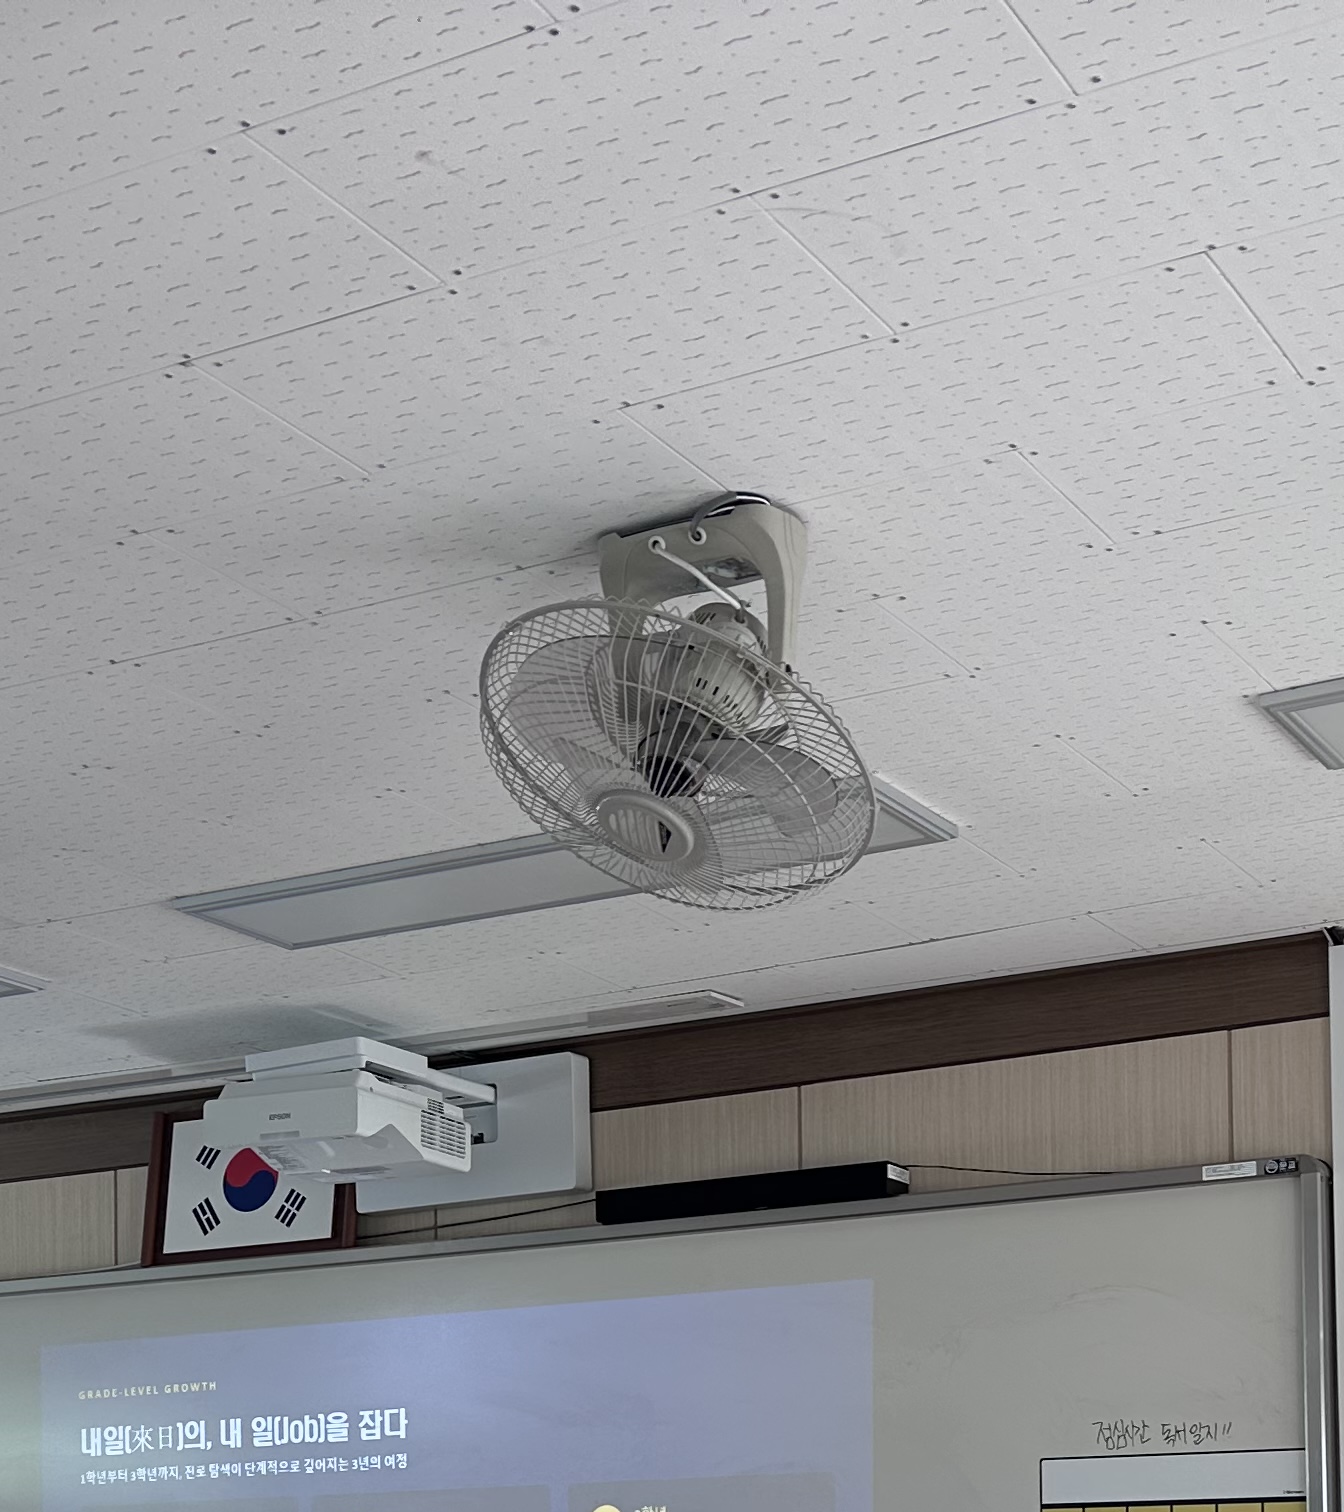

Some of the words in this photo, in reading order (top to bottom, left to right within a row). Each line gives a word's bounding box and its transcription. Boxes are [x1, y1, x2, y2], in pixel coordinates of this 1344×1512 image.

[78, 1384, 159, 1400] GRADE-LEVEL
[164, 1380, 217, 1395] GROWTH
[220, 1417, 243, 1449] 내
[251, 1411, 349, 1448] 일(Job)을
[358, 1408, 408, 1441] 잡다
[80, 1469, 128, 1485] 1학년부터
[130, 1466, 182, 1482] 3학년까지,
[184, 1464, 206, 1479] 진로
[209, 1462, 242, 1478] 탐색이
[245, 1459, 301, 1476] 단계적으로
[303, 1457, 348, 1473] 깊어지는
[352, 1455, 381, 1471] 3년의
[384, 1453, 408, 1469] 여정
